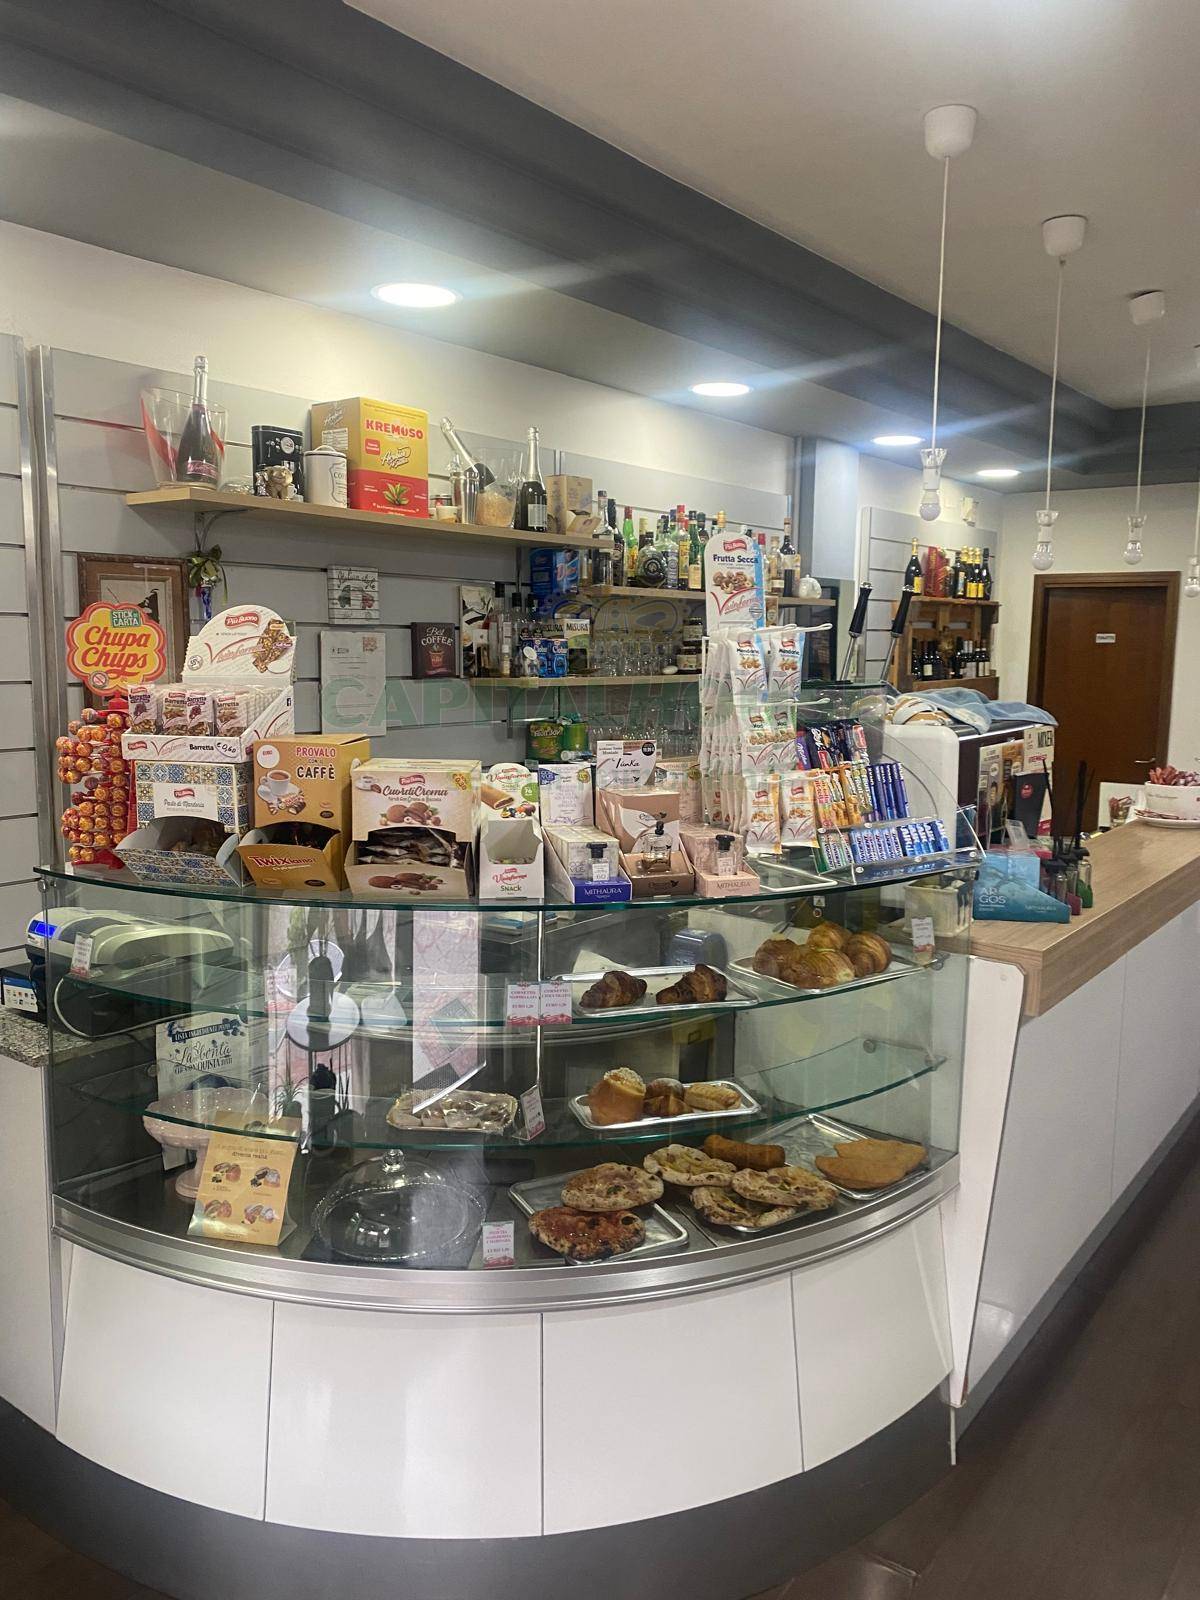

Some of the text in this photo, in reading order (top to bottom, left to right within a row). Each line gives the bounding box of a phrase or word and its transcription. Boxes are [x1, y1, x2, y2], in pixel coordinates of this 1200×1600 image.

[713, 554, 758, 564] Frutta Secca
[112, 610, 133, 619] STICK
[113, 617, 139, 627] CARTA
[566, 623, 589, 632] MISURA
[85, 625, 151, 652] Chupa
[421, 635, 453, 646] COFFEE
[81, 646, 147, 672] Chups
[189, 743, 214, 753] Barretta
[296, 747, 336, 757] PROVALO
[296, 764, 335, 779] CAFFÈ
[584, 887, 622, 896] MITHAURA
